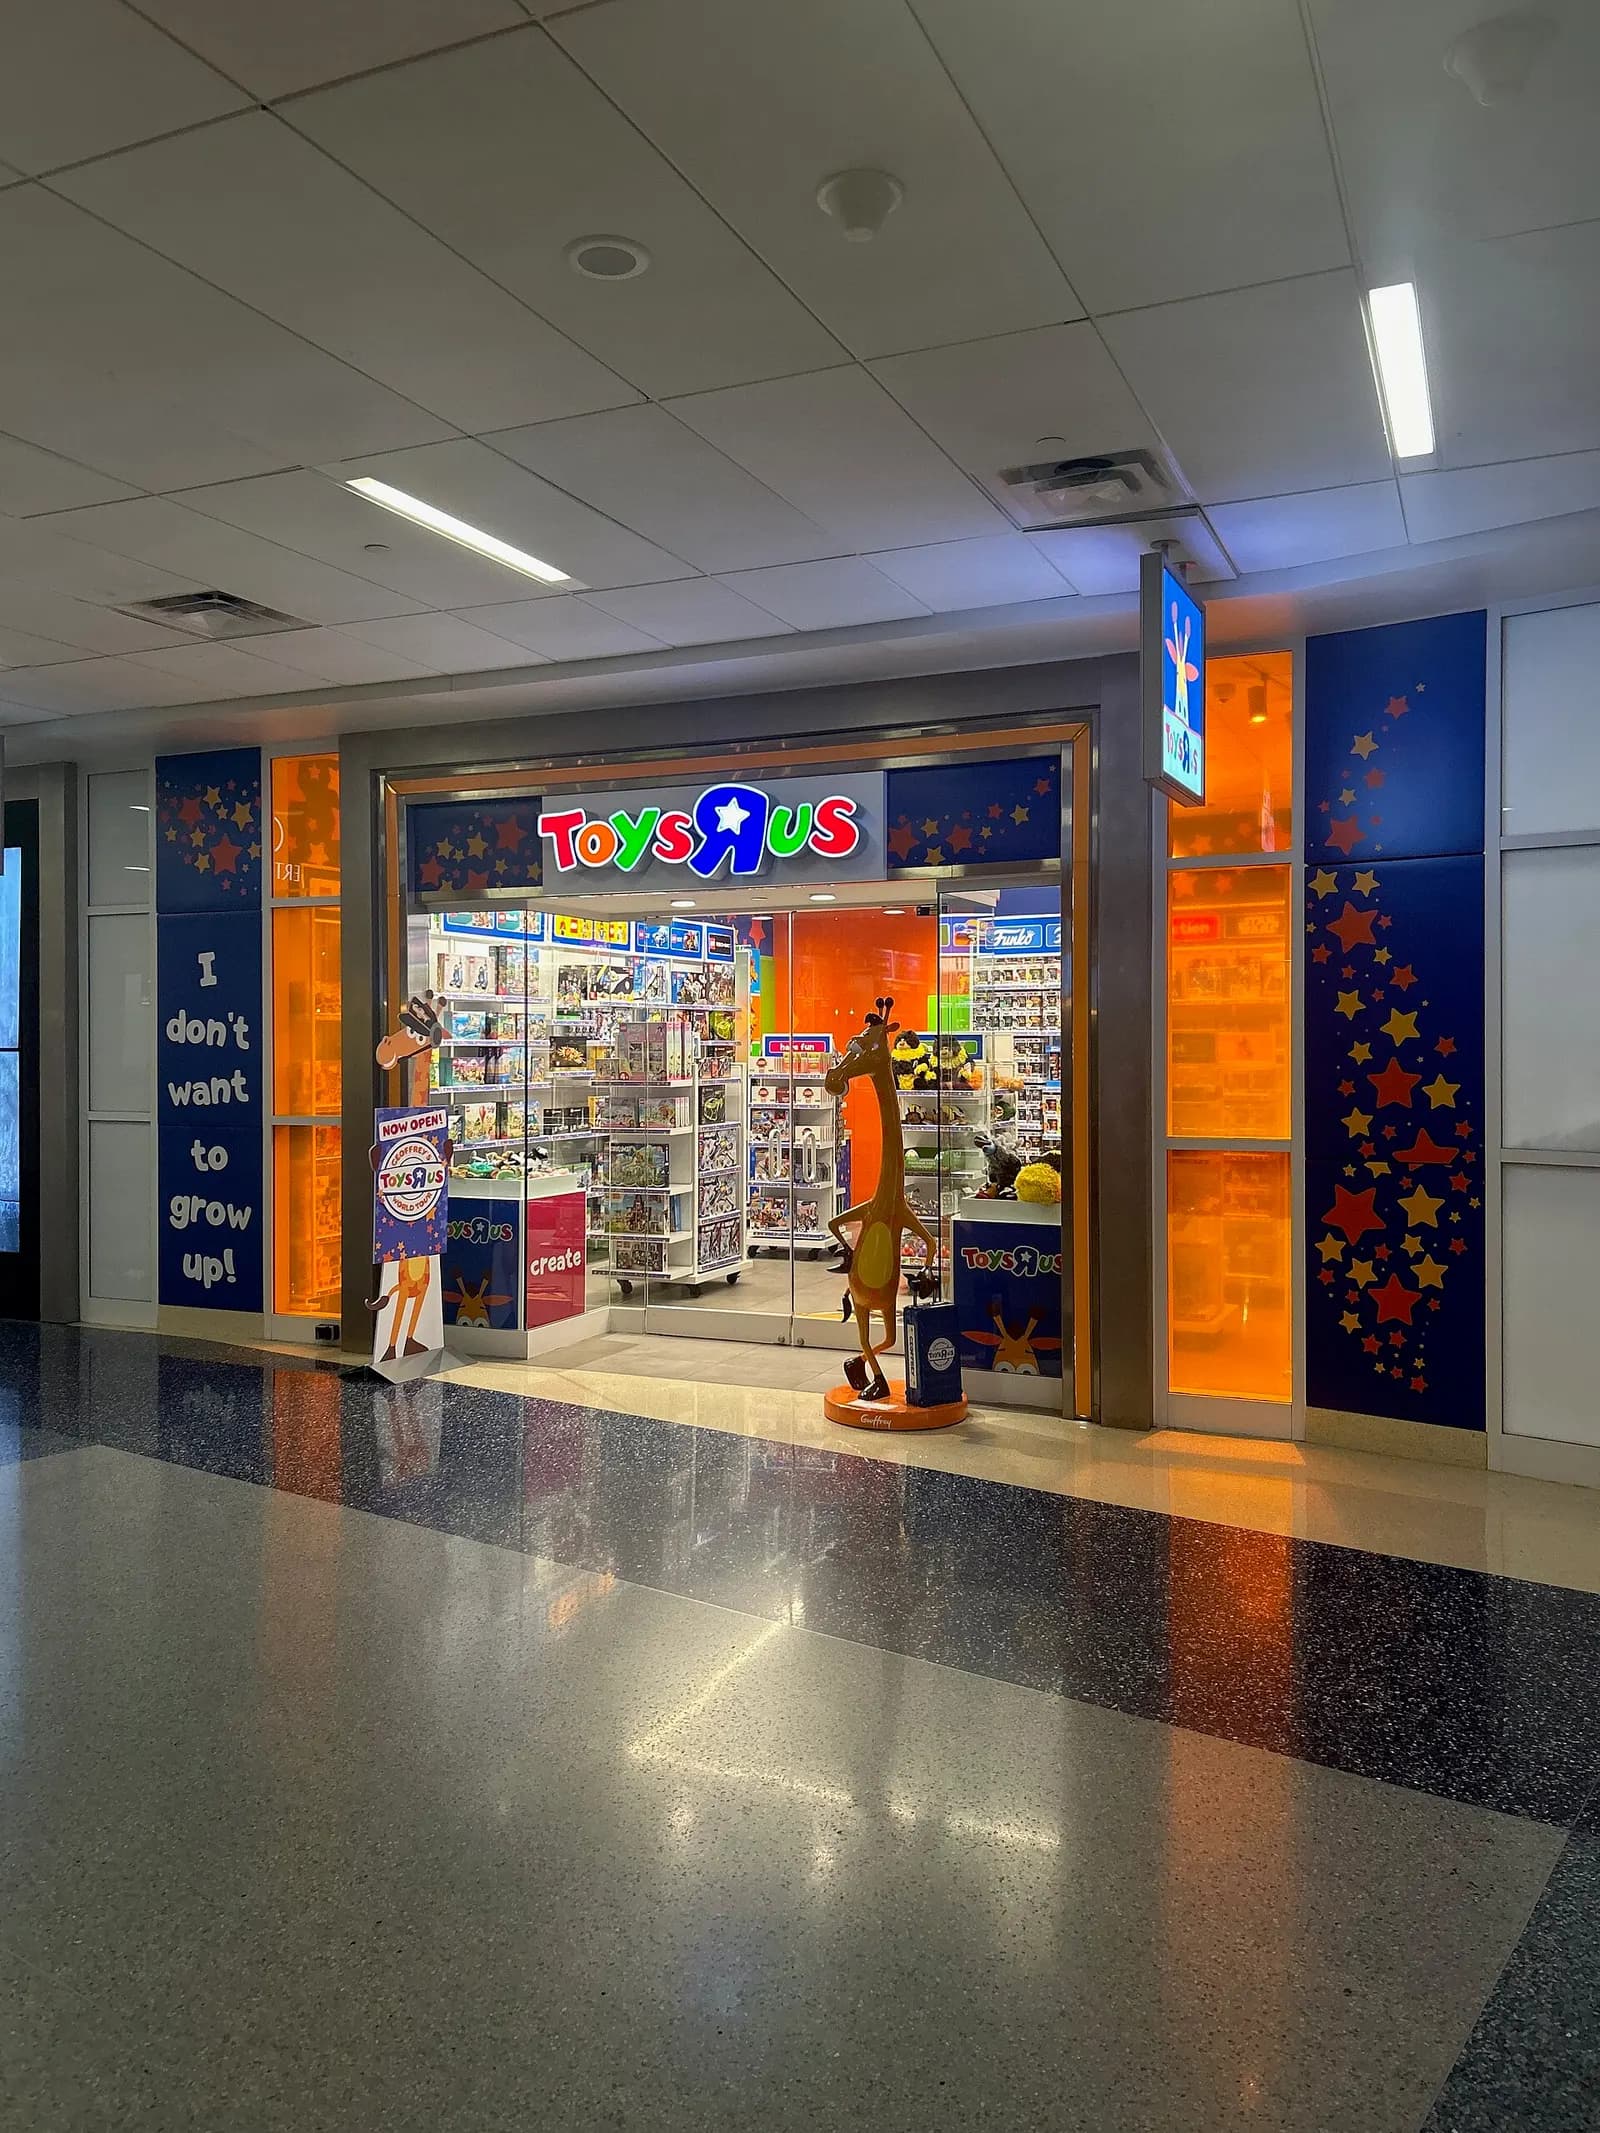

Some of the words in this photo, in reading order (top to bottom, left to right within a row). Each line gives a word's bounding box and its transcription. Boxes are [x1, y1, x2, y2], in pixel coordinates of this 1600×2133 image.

[993, 928, 1035, 946] Funko
[198, 952, 217, 987] I
[166, 1009, 249, 1050] don't
[801, 1043, 815, 1051] fun
[168, 1070, 249, 1107] want
[382, 1122, 408, 1137] NOW
[410, 1113, 443, 1132] OPEN!
[190, 1139, 228, 1171] to
[391, 1145, 432, 1167] GEOFFREY'S
[169, 1195, 252, 1230] grow
[393, 1195, 414, 1212] WORLD
[416, 1192, 433, 1208] TOUR
[182, 1249, 236, 1289] up!
[530, 1248, 582, 1276] create
[860, 1413, 893, 1429] Geoffrey
